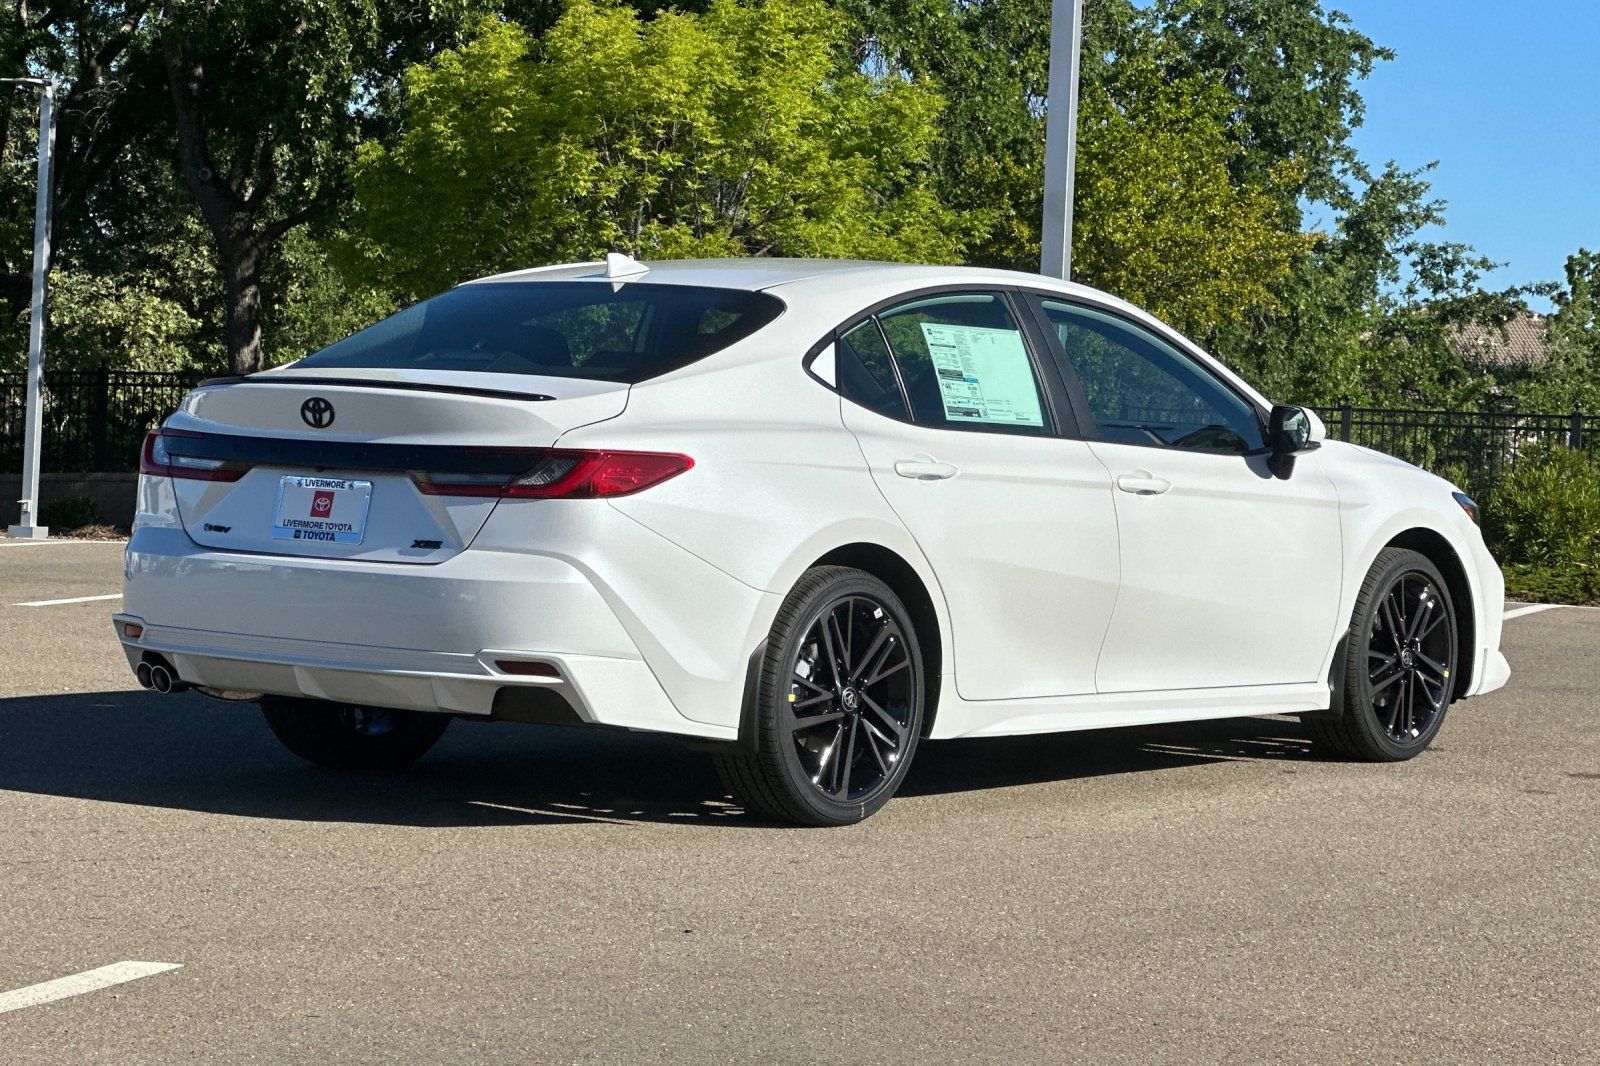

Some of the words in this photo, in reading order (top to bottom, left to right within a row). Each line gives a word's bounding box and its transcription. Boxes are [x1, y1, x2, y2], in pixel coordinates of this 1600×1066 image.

[304, 479, 346, 489] LIVERMORE
[282, 518, 324, 529] LIVERMORE
[324, 522, 353, 532] TOYOTA
[302, 530, 336, 541] TOYOTA
